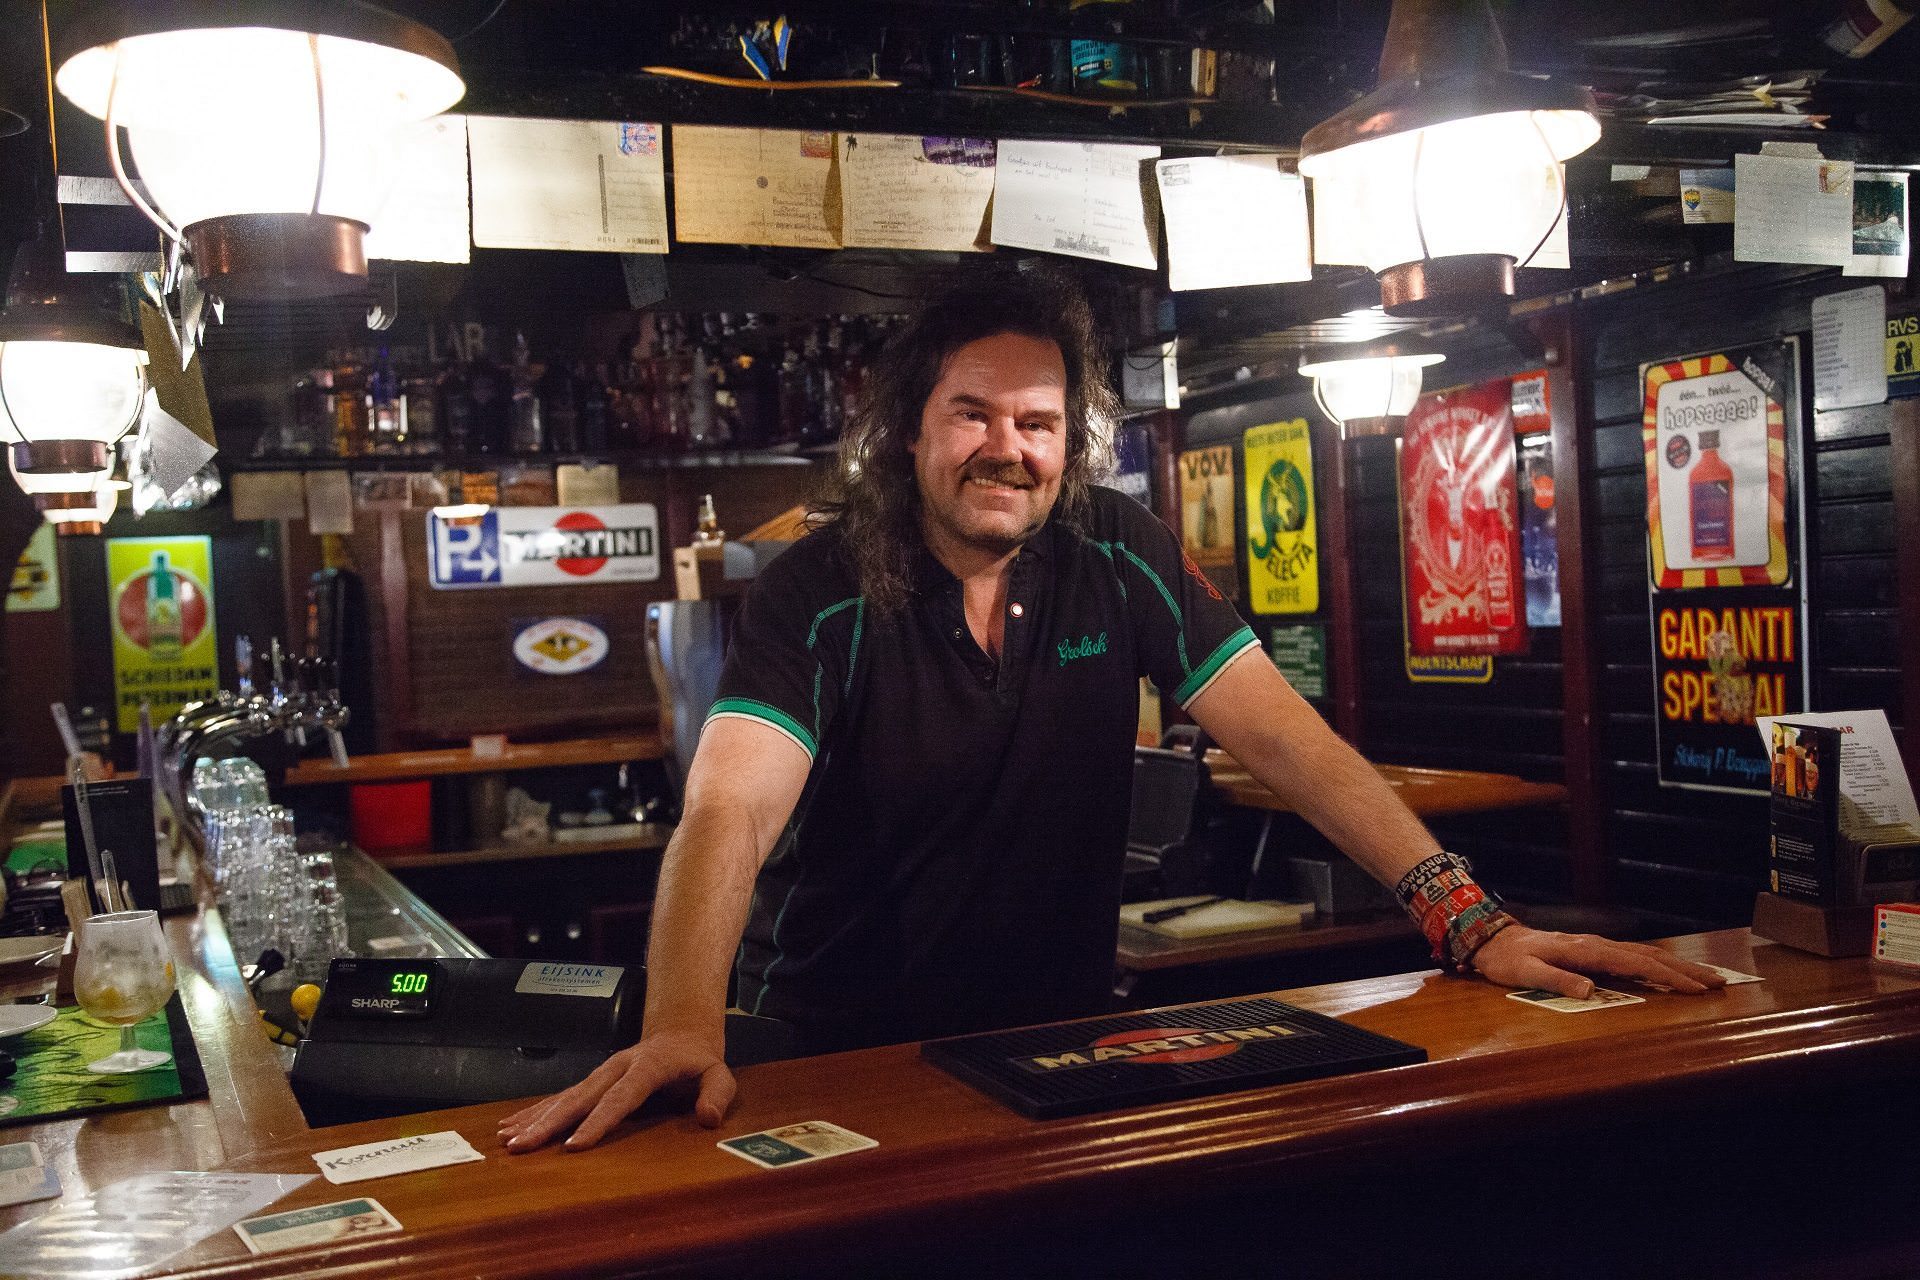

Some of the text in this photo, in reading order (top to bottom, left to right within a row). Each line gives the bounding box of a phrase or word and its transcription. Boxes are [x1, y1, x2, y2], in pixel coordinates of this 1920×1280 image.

[1887, 317, 1918, 336] RVS
[1057, 631, 1108, 666] Grolsch
[1660, 607, 1794, 661] GARANTI
[392, 973, 428, 992] 5.00
[351, 998, 400, 1008] SHARP
[1032, 1024, 1296, 1069] MARTINI
[325, 1137, 432, 1170] Kornuit
